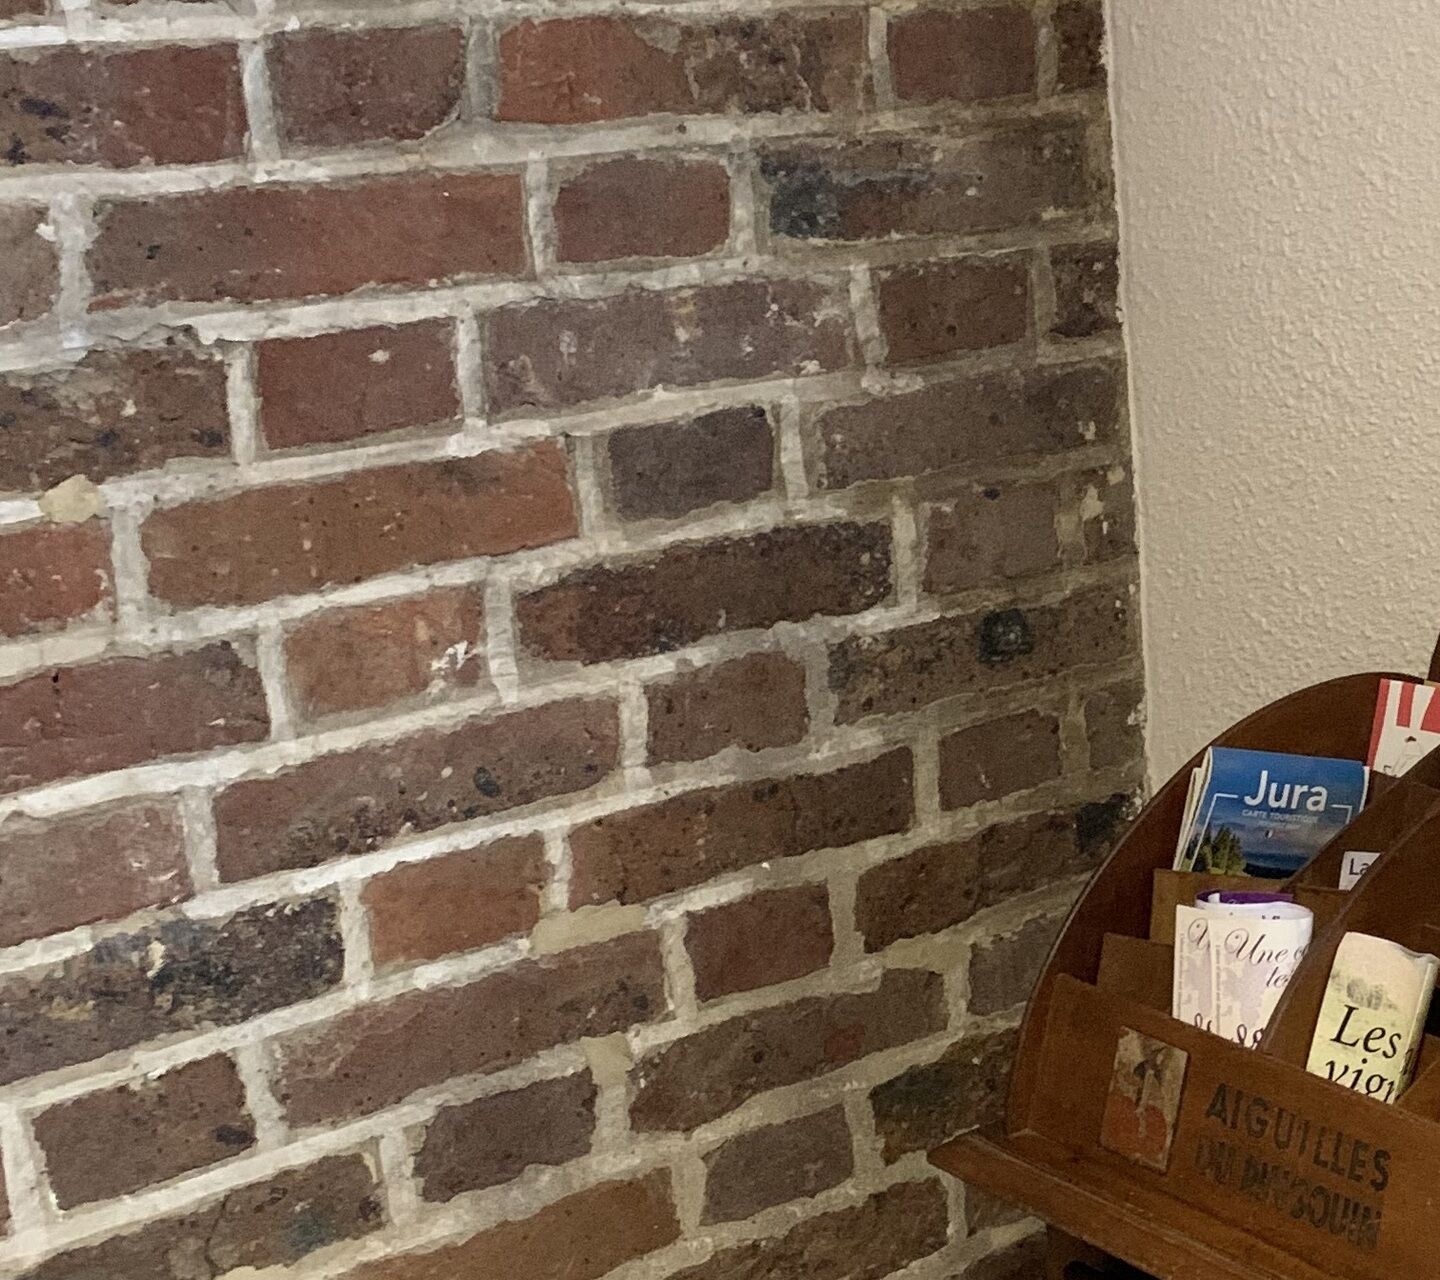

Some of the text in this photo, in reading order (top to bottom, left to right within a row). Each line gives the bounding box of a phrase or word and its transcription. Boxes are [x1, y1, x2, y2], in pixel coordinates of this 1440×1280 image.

[1243, 770, 1329, 812] Jura
[1224, 928, 1288, 967] Une
[1330, 1004, 1402, 1059] Les
[1204, 1082, 1392, 1192] AIGUILLES
